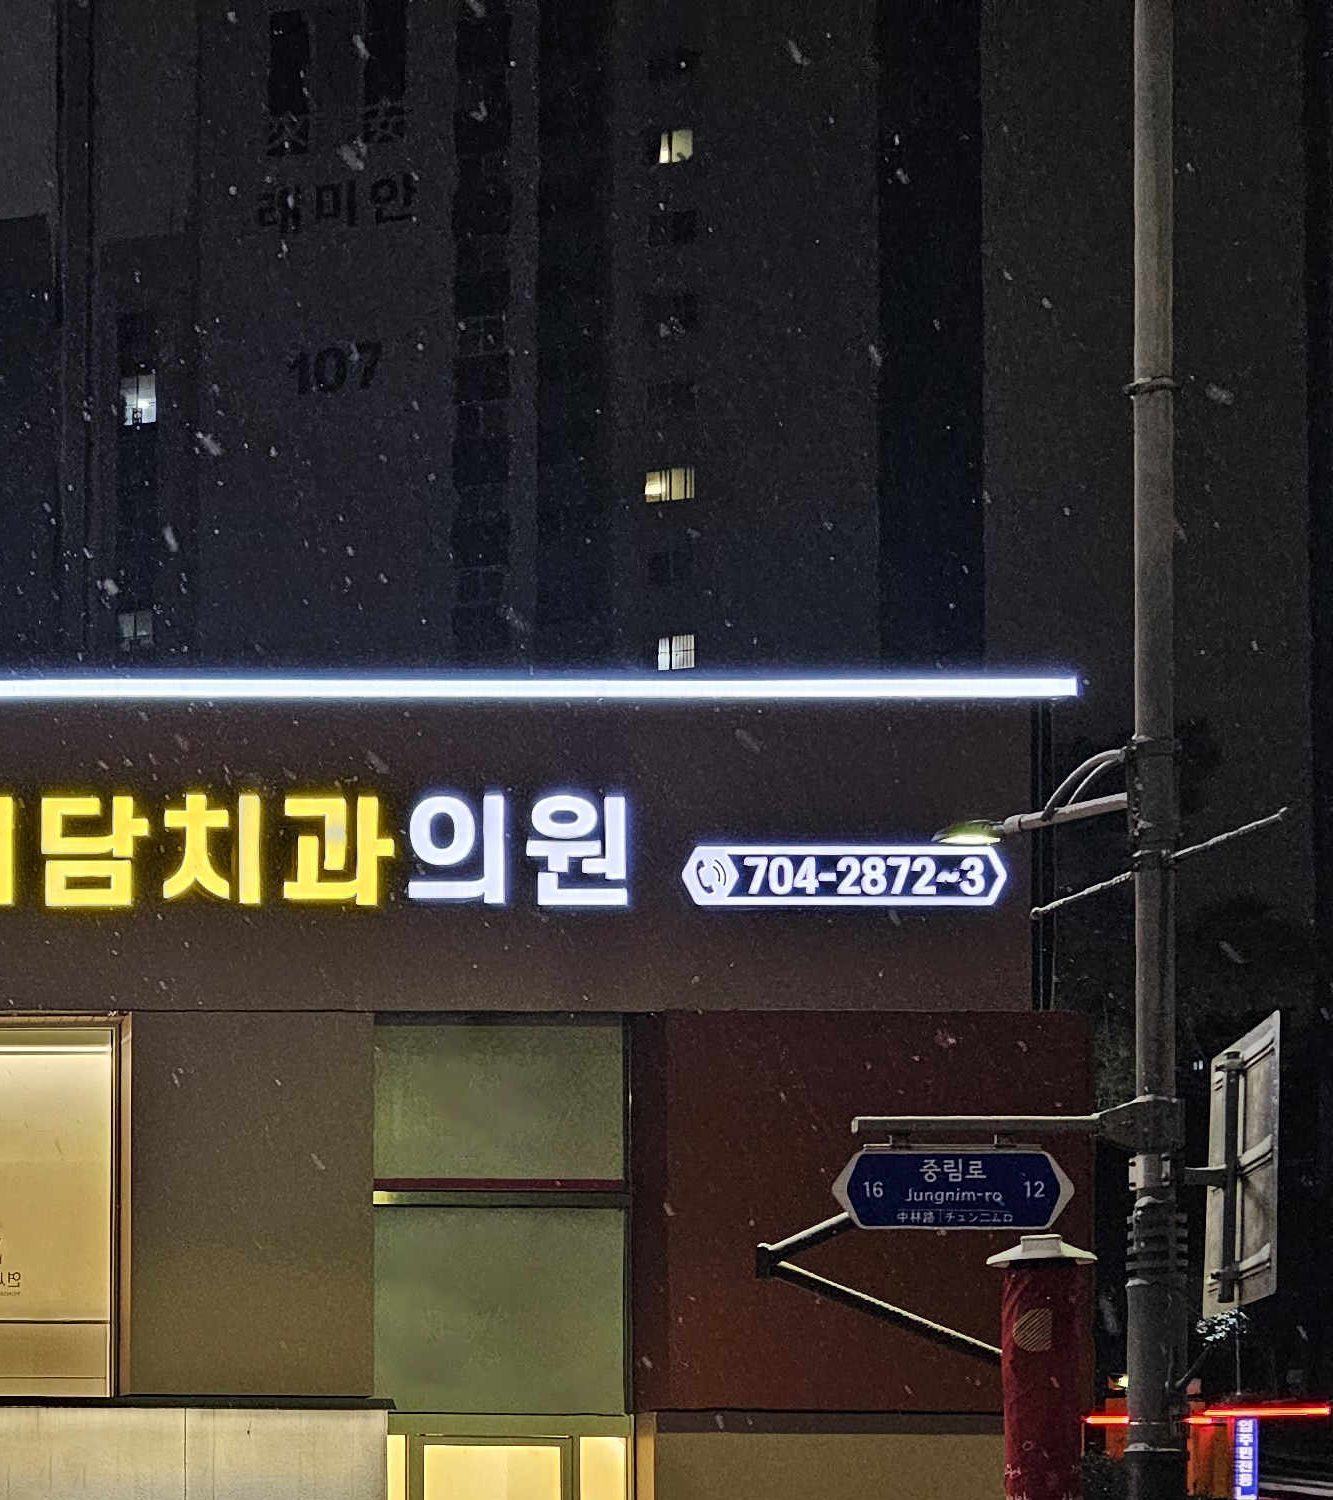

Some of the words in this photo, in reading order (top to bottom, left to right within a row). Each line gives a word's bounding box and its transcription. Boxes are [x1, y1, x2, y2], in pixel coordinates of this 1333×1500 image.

[257, 172, 417, 235] 래미안
[289, 339, 384, 395] 107
[743, 855, 989, 897] 704-2872~3
[919, 1158, 987, 1183] 중림로
[862, 1181, 884, 1198] 16
[904, 1187, 1005, 1205] Jungnim-ro
[1023, 1180, 1046, 1198] 12
[896, 1211, 935, 1223] 中林路
